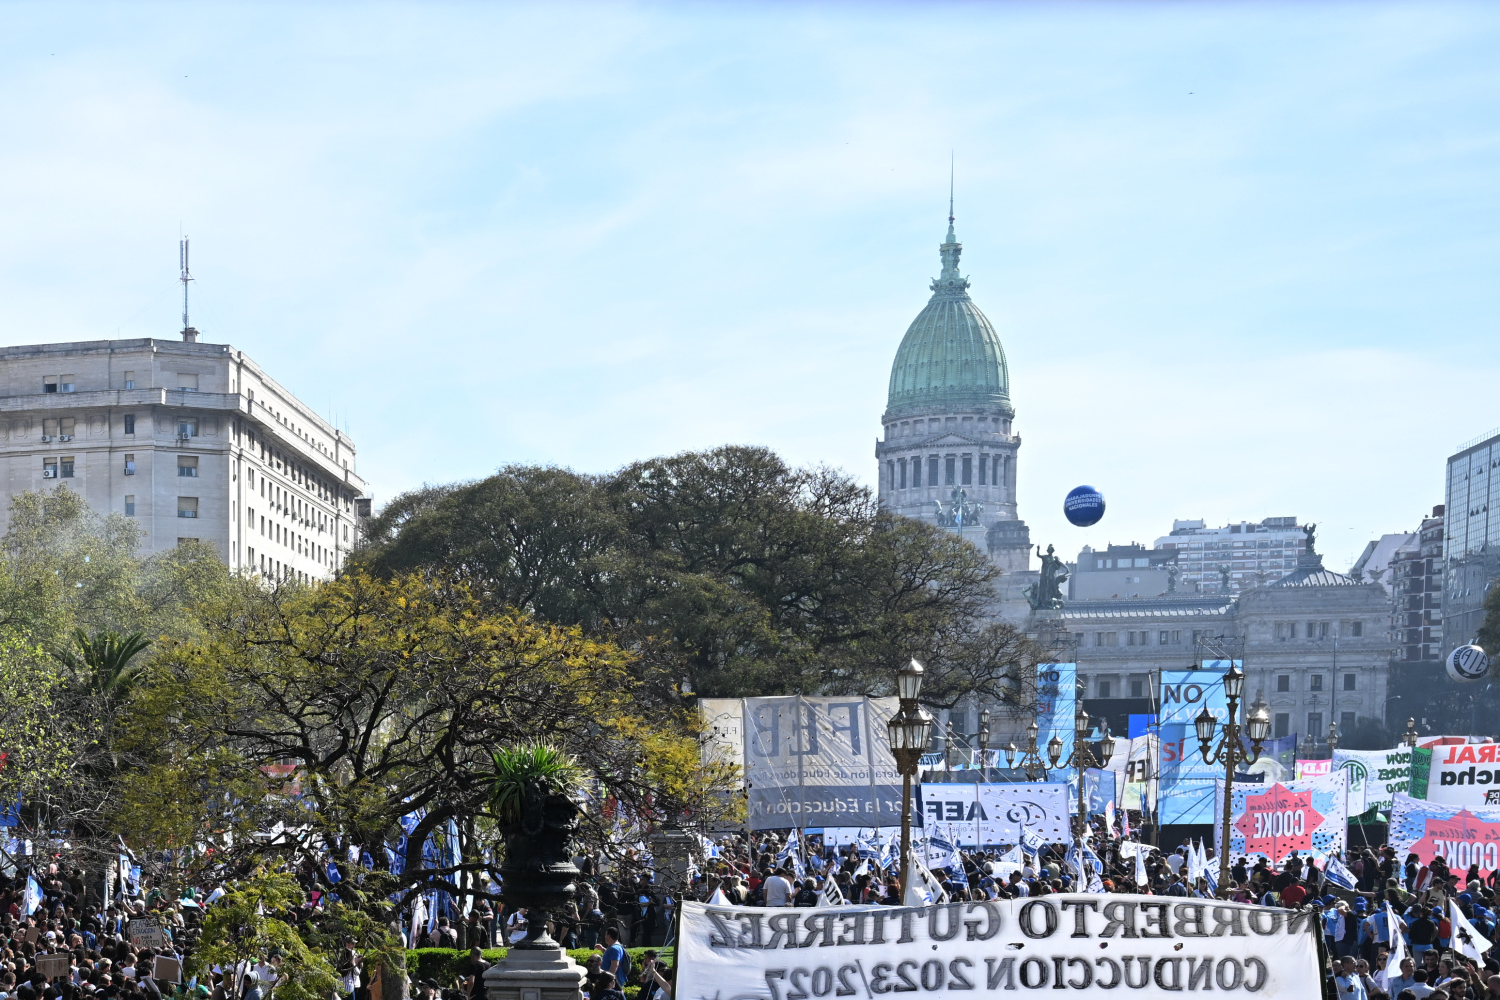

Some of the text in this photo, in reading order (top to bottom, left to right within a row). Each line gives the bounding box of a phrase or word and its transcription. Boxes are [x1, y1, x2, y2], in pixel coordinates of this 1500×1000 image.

[1461, 649, 1487, 671] ATE
[1164, 684, 1203, 704] NO
[1163, 708, 1182, 720] AL
[1162, 738, 1185, 762] SÍ
[1161, 764, 1226, 774] UNIVERSIDAD
